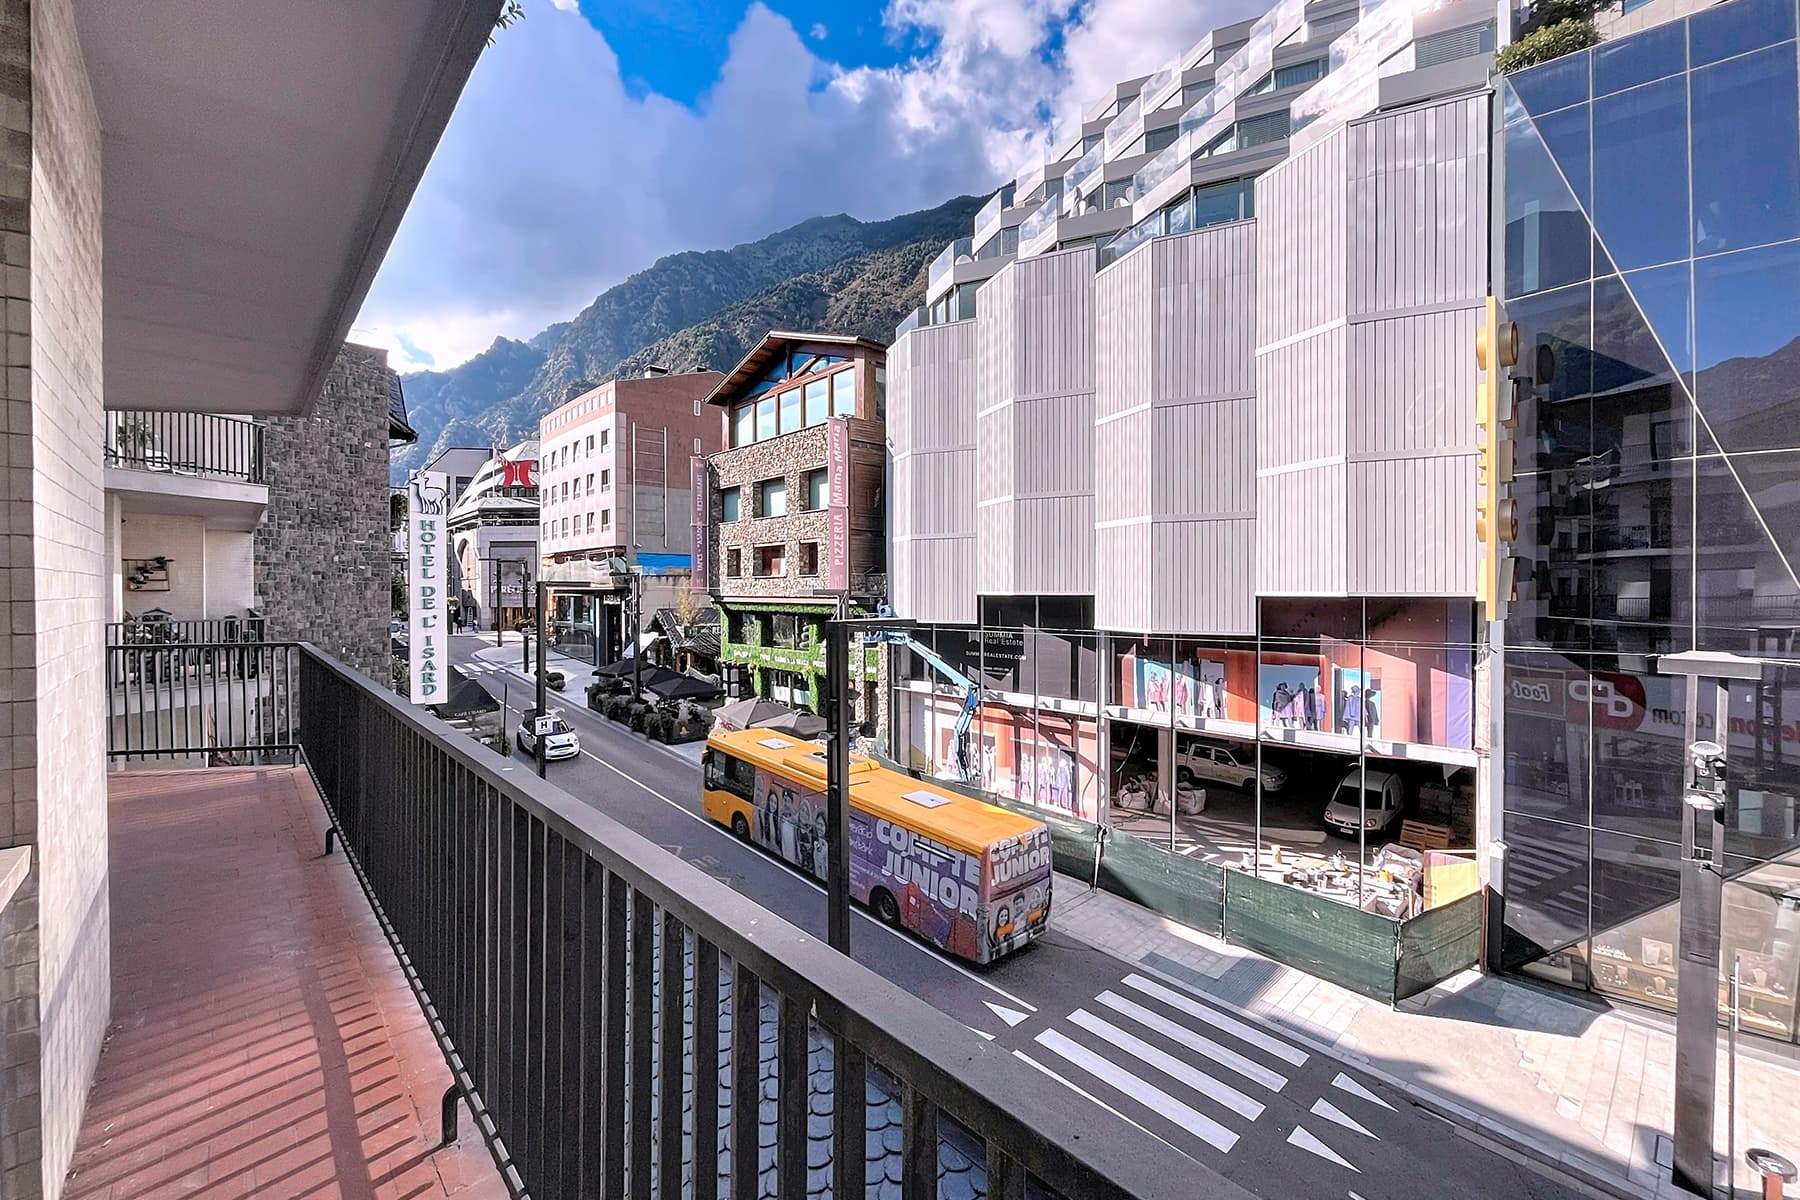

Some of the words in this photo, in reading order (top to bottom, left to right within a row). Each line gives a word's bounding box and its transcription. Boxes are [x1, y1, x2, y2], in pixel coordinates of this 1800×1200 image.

[832, 425, 843, 462] Maria
[832, 465, 844, 504] Mama
[420, 520, 436, 579] HOTEL
[833, 514, 844, 566] PIZZERIA
[421, 586, 436, 610] DE
[540, 720, 548, 729] H
[882, 850, 978, 921] JUNIOR
[991, 846, 1050, 887] JUNIOR
